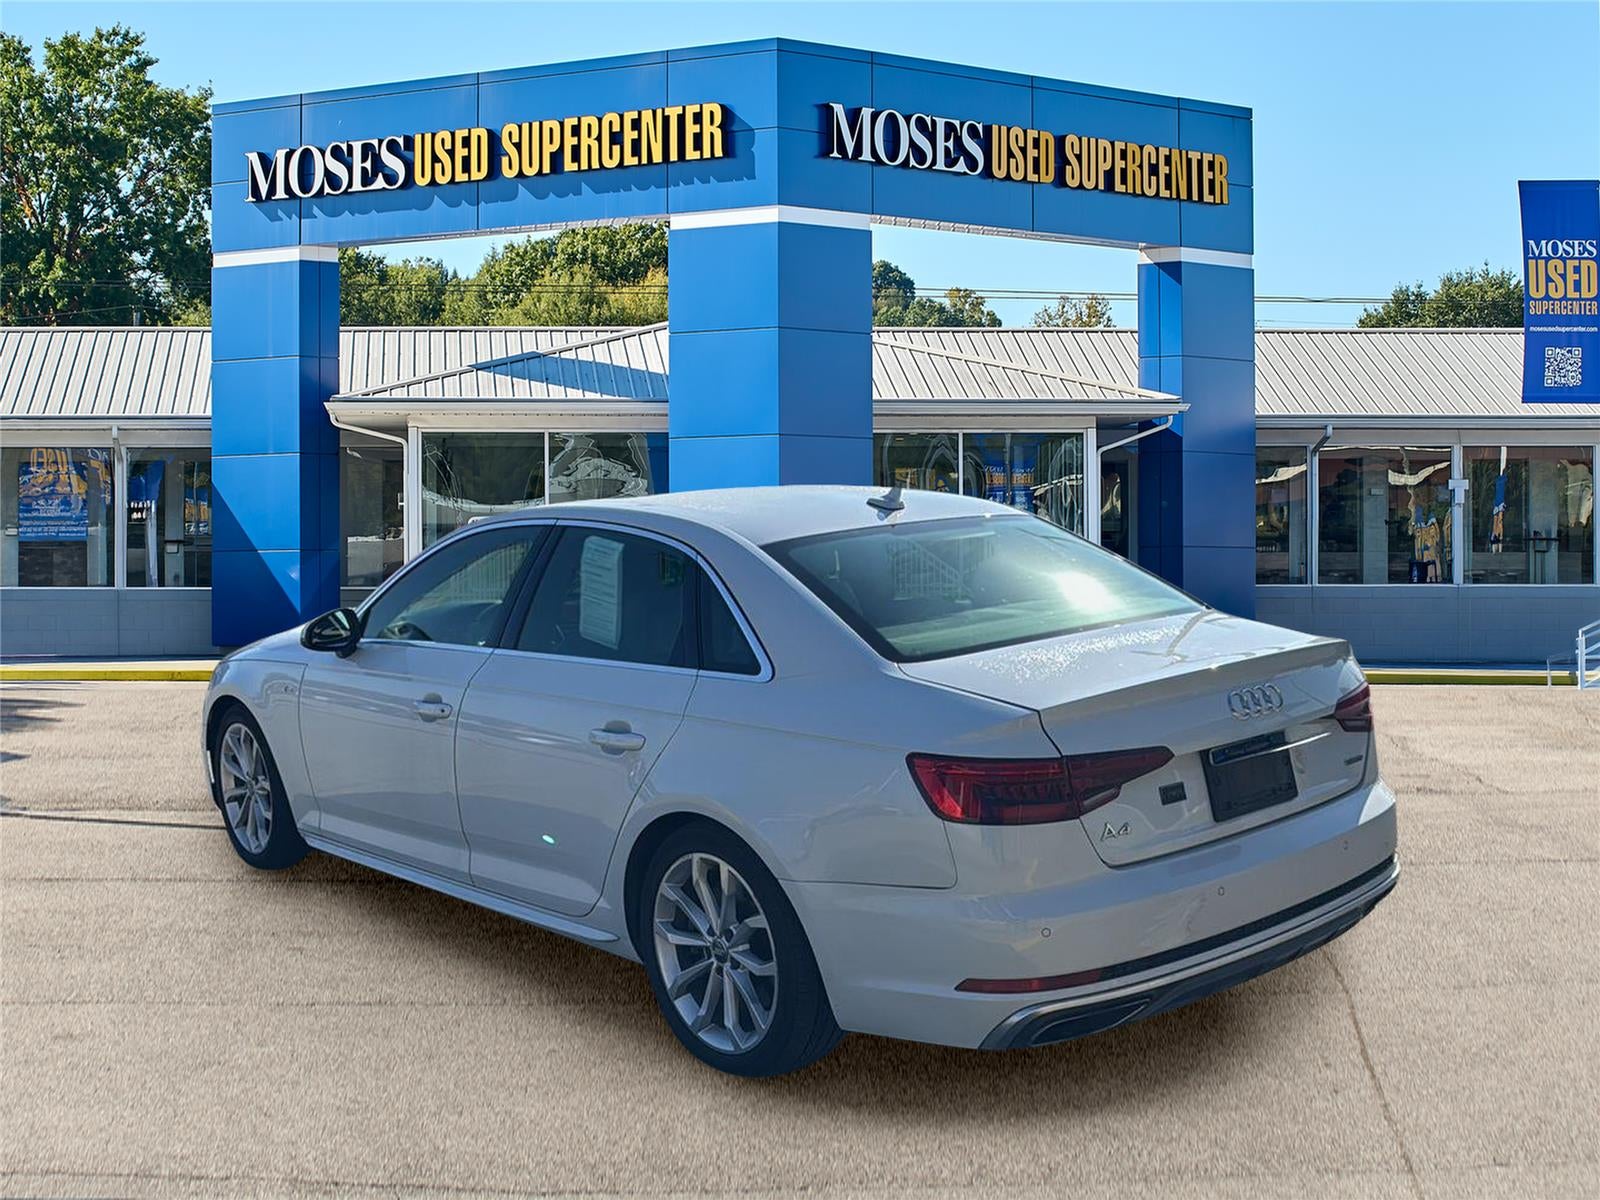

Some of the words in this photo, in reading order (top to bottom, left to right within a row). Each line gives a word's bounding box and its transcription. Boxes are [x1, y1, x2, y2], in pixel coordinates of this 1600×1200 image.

[245, 136, 406, 202] MOSES
[413, 126, 489, 187] USED
[500, 102, 724, 179] SUPERCENTER
[829, 102, 984, 176] MOSES
[991, 124, 1055, 183] USED
[1064, 134, 1229, 204] SUPERCENTER
[1527, 239, 1597, 258] MOSES
[1528, 258, 1598, 299] USED
[1529, 300, 1598, 315] SUPERCENTER
[1100, 821, 1130, 841] A4
